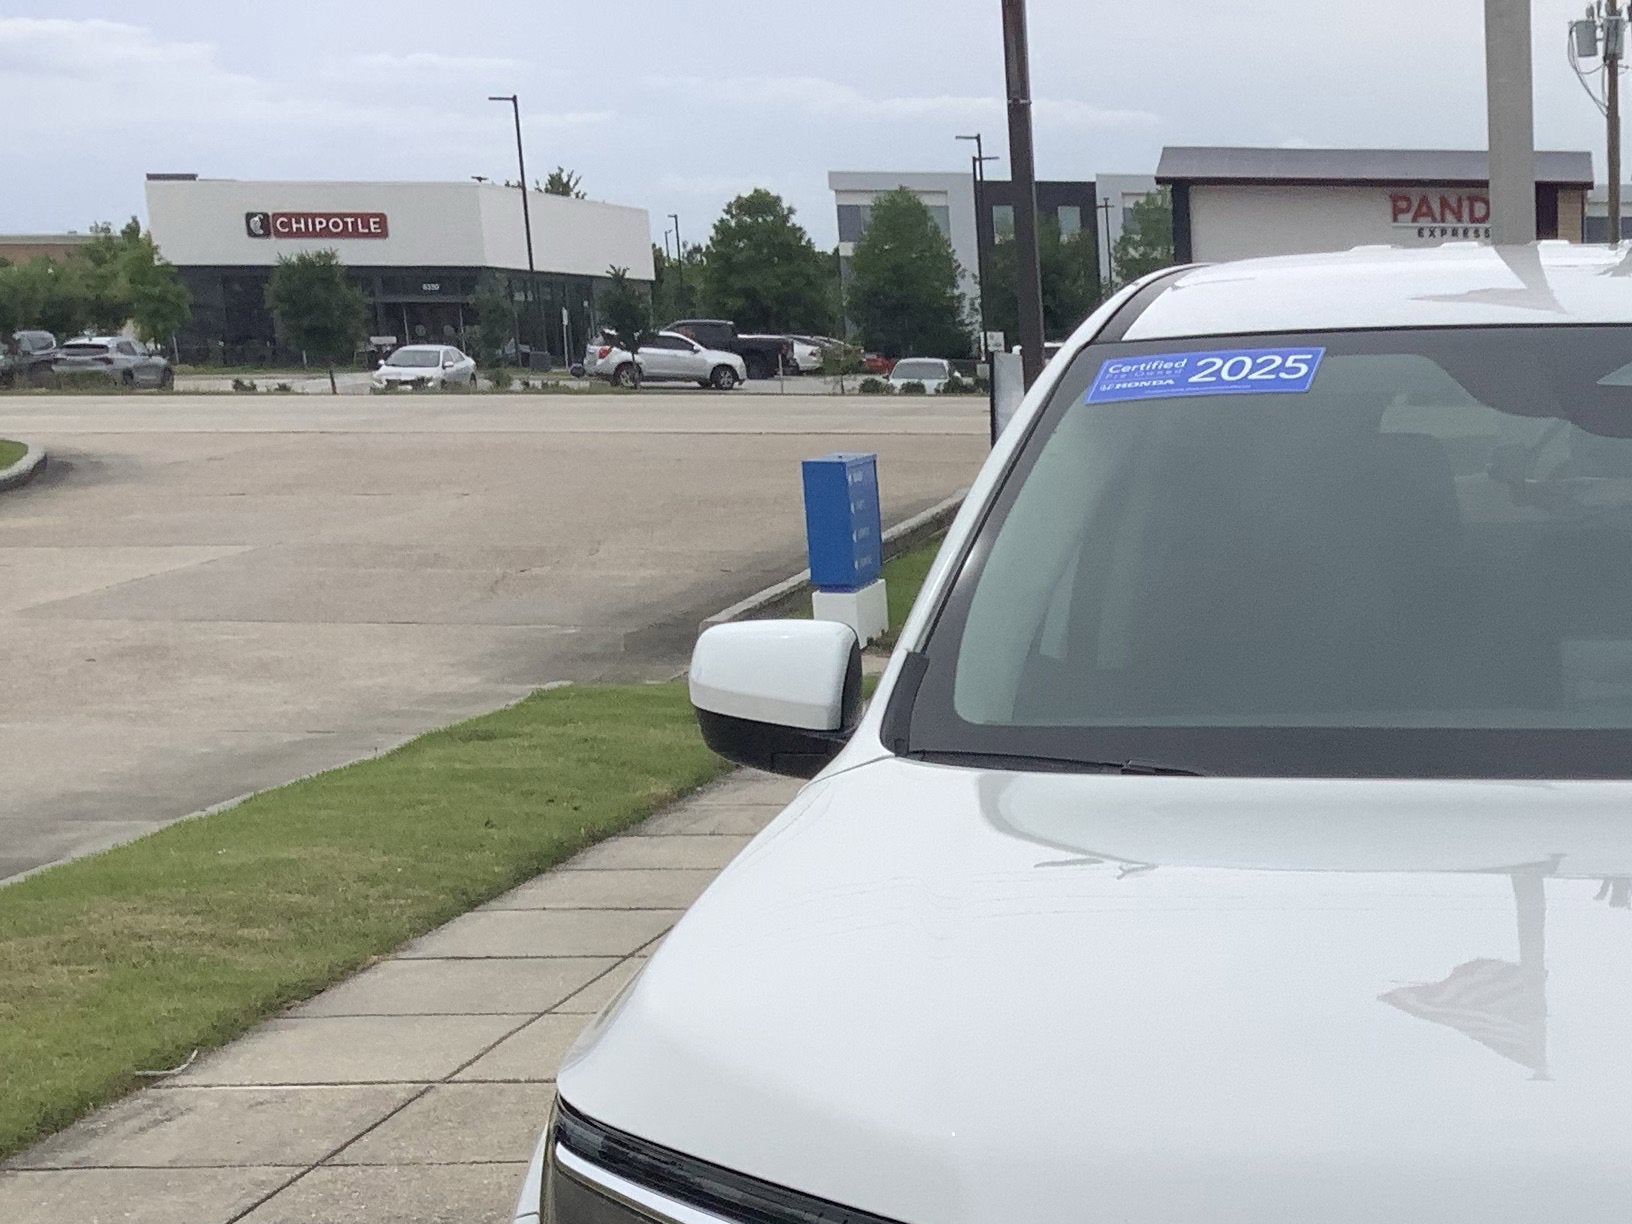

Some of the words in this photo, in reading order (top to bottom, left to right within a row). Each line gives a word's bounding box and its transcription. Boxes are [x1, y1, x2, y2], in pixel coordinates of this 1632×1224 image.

[1390, 193, 1490, 224] PAND
[276, 217, 383, 233] CHIPOTLE
[1417, 226, 1491, 238] EXPRESS
[1108, 358, 1188, 374] Certified
[1188, 354, 1312, 383] 2025
[1114, 379, 1175, 390] HONDA
